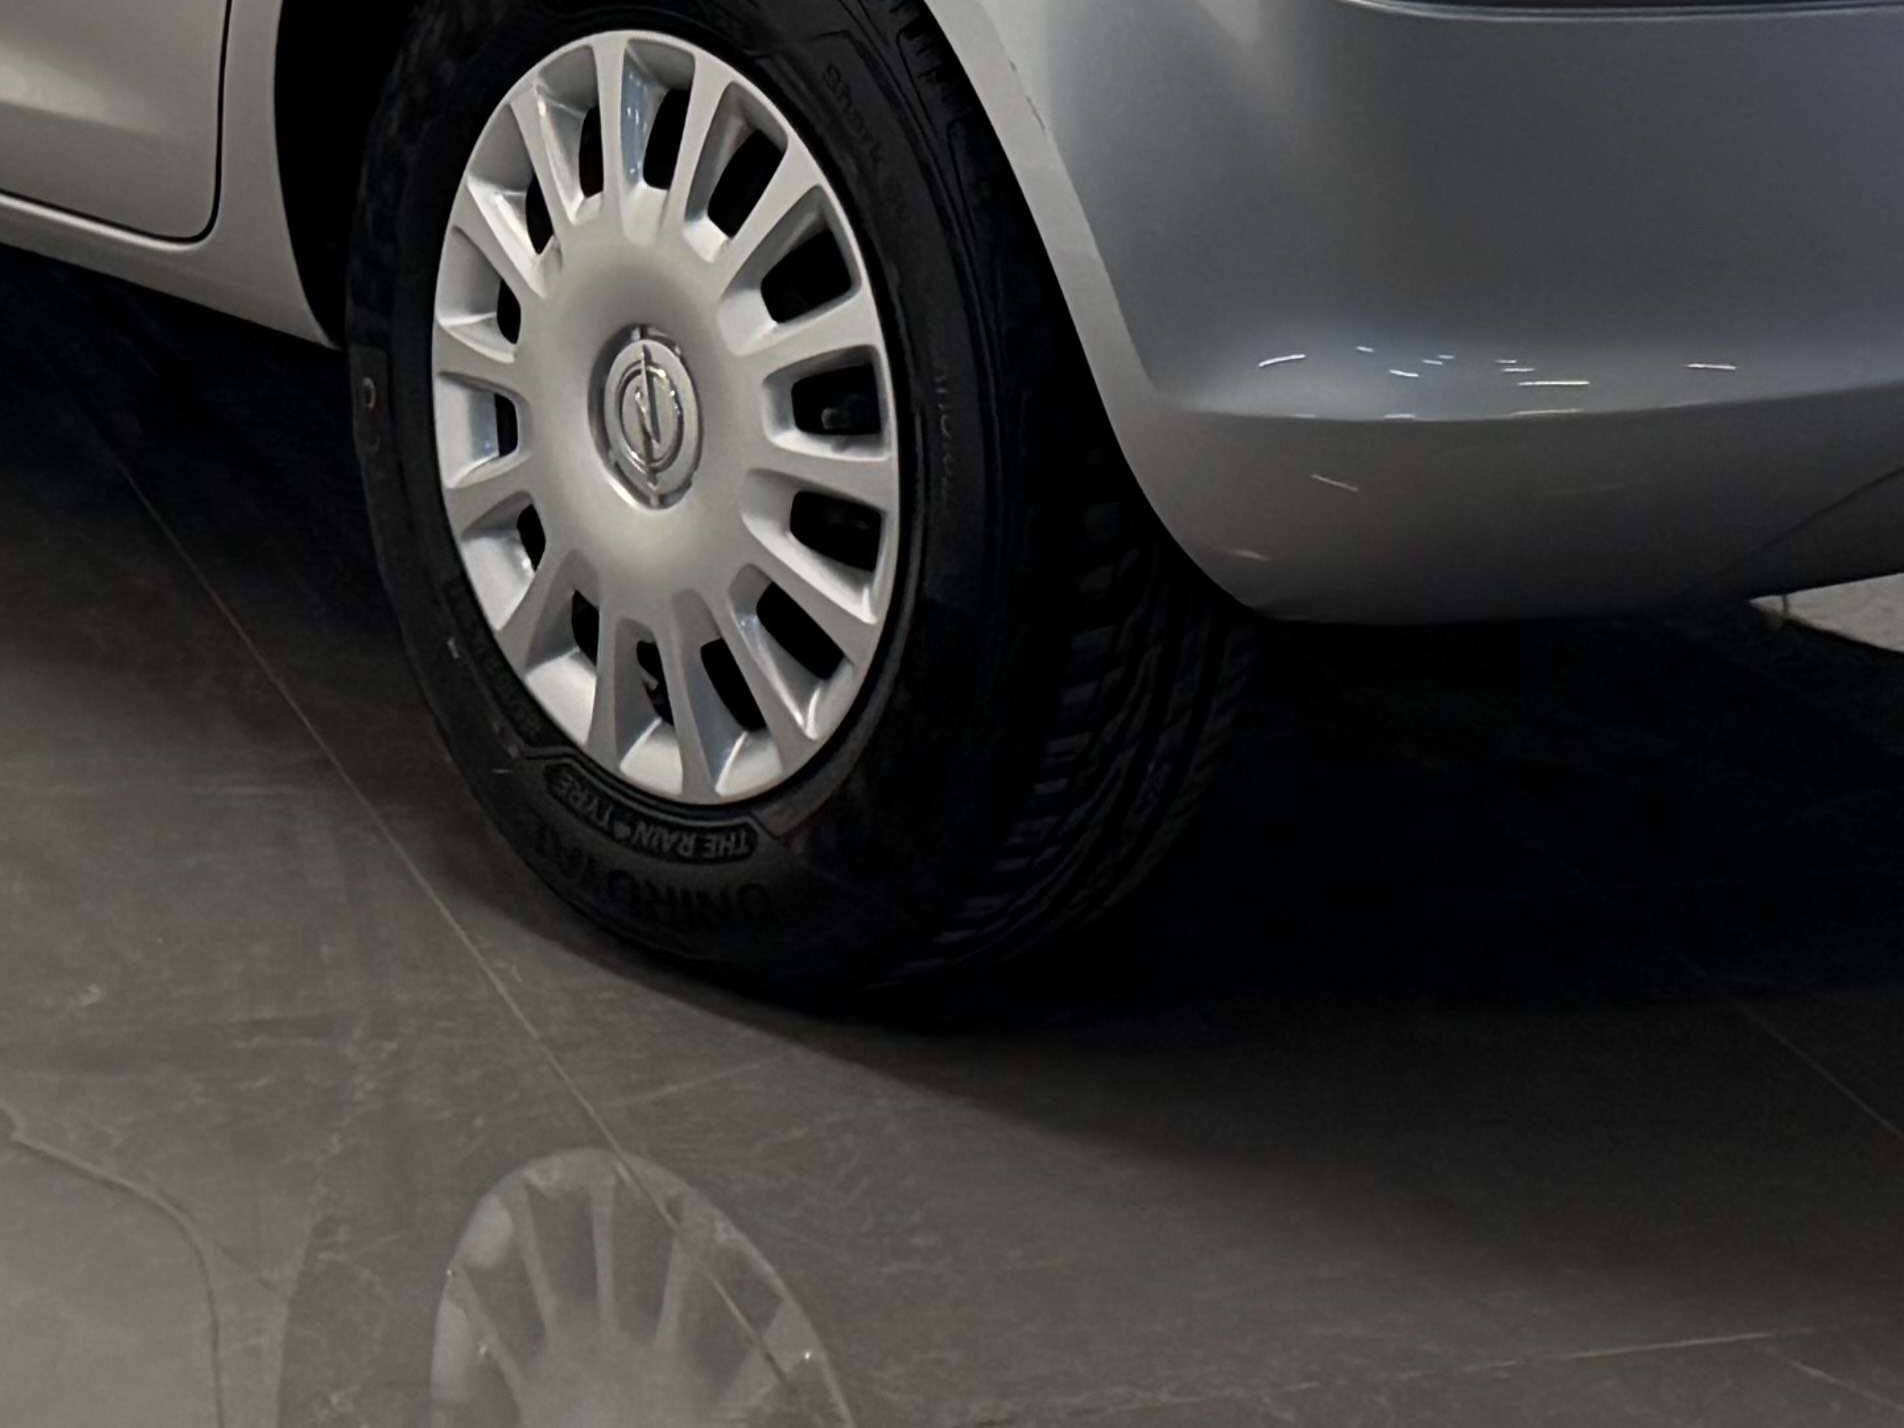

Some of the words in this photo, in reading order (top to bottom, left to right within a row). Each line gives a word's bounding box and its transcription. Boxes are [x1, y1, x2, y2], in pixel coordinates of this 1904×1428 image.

[551, 770, 614, 830] TYRE
[632, 820, 698, 856] RAIN
[702, 829, 751, 856] THE
